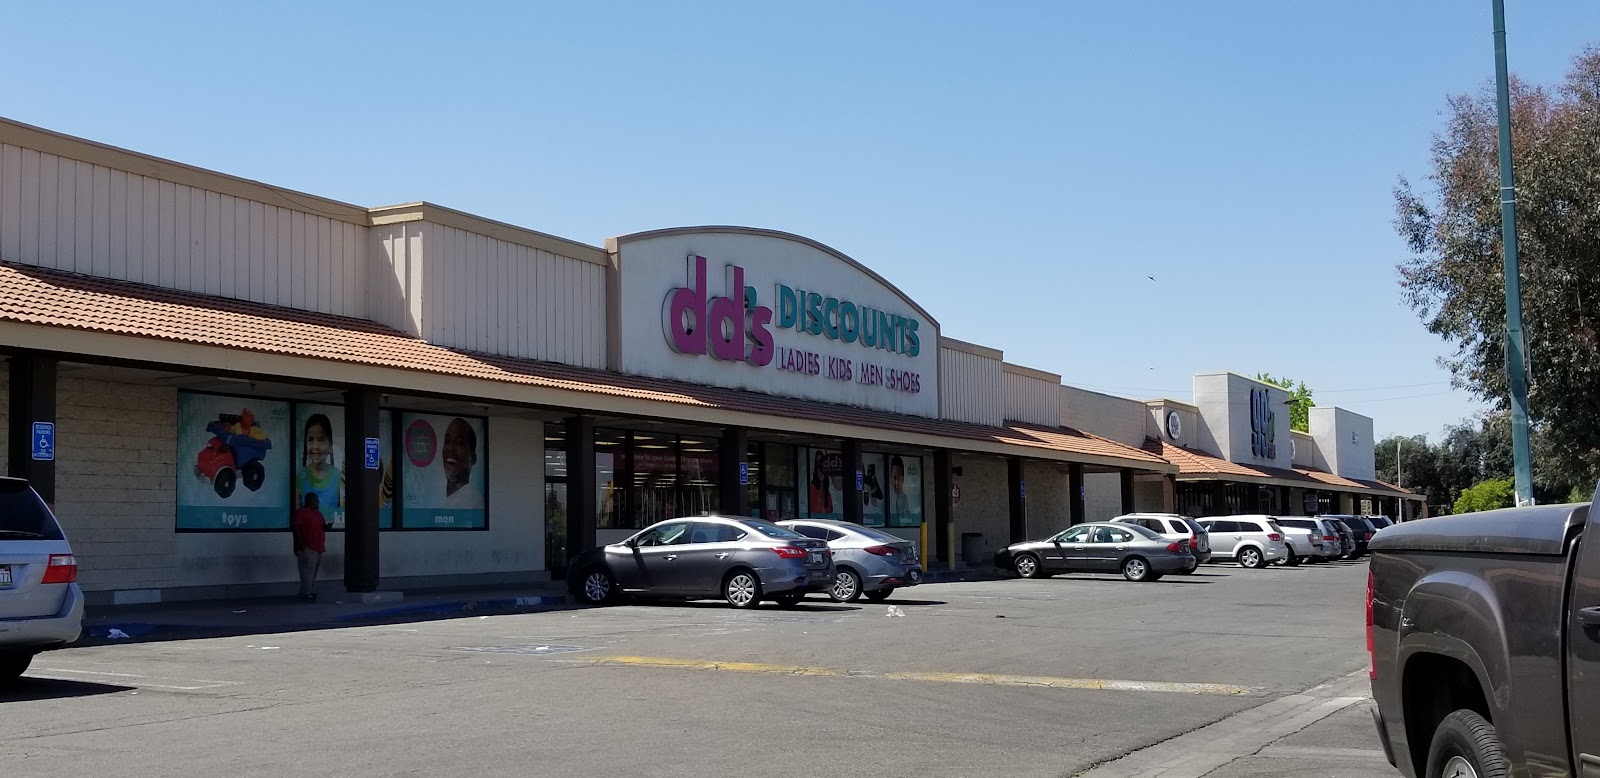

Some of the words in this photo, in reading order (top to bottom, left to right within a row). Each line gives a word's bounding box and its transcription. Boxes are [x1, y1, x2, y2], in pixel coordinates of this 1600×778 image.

[662, 255, 774, 366] dd's
[775, 284, 920, 357] DISCOUNTS
[777, 347, 820, 376] LADIES
[823, 355, 852, 381] KIDS
[857, 362, 883, 387] MEN
[887, 368, 920, 393] SHOES
[221, 512, 248, 526] toys
[434, 515, 455, 524] men
